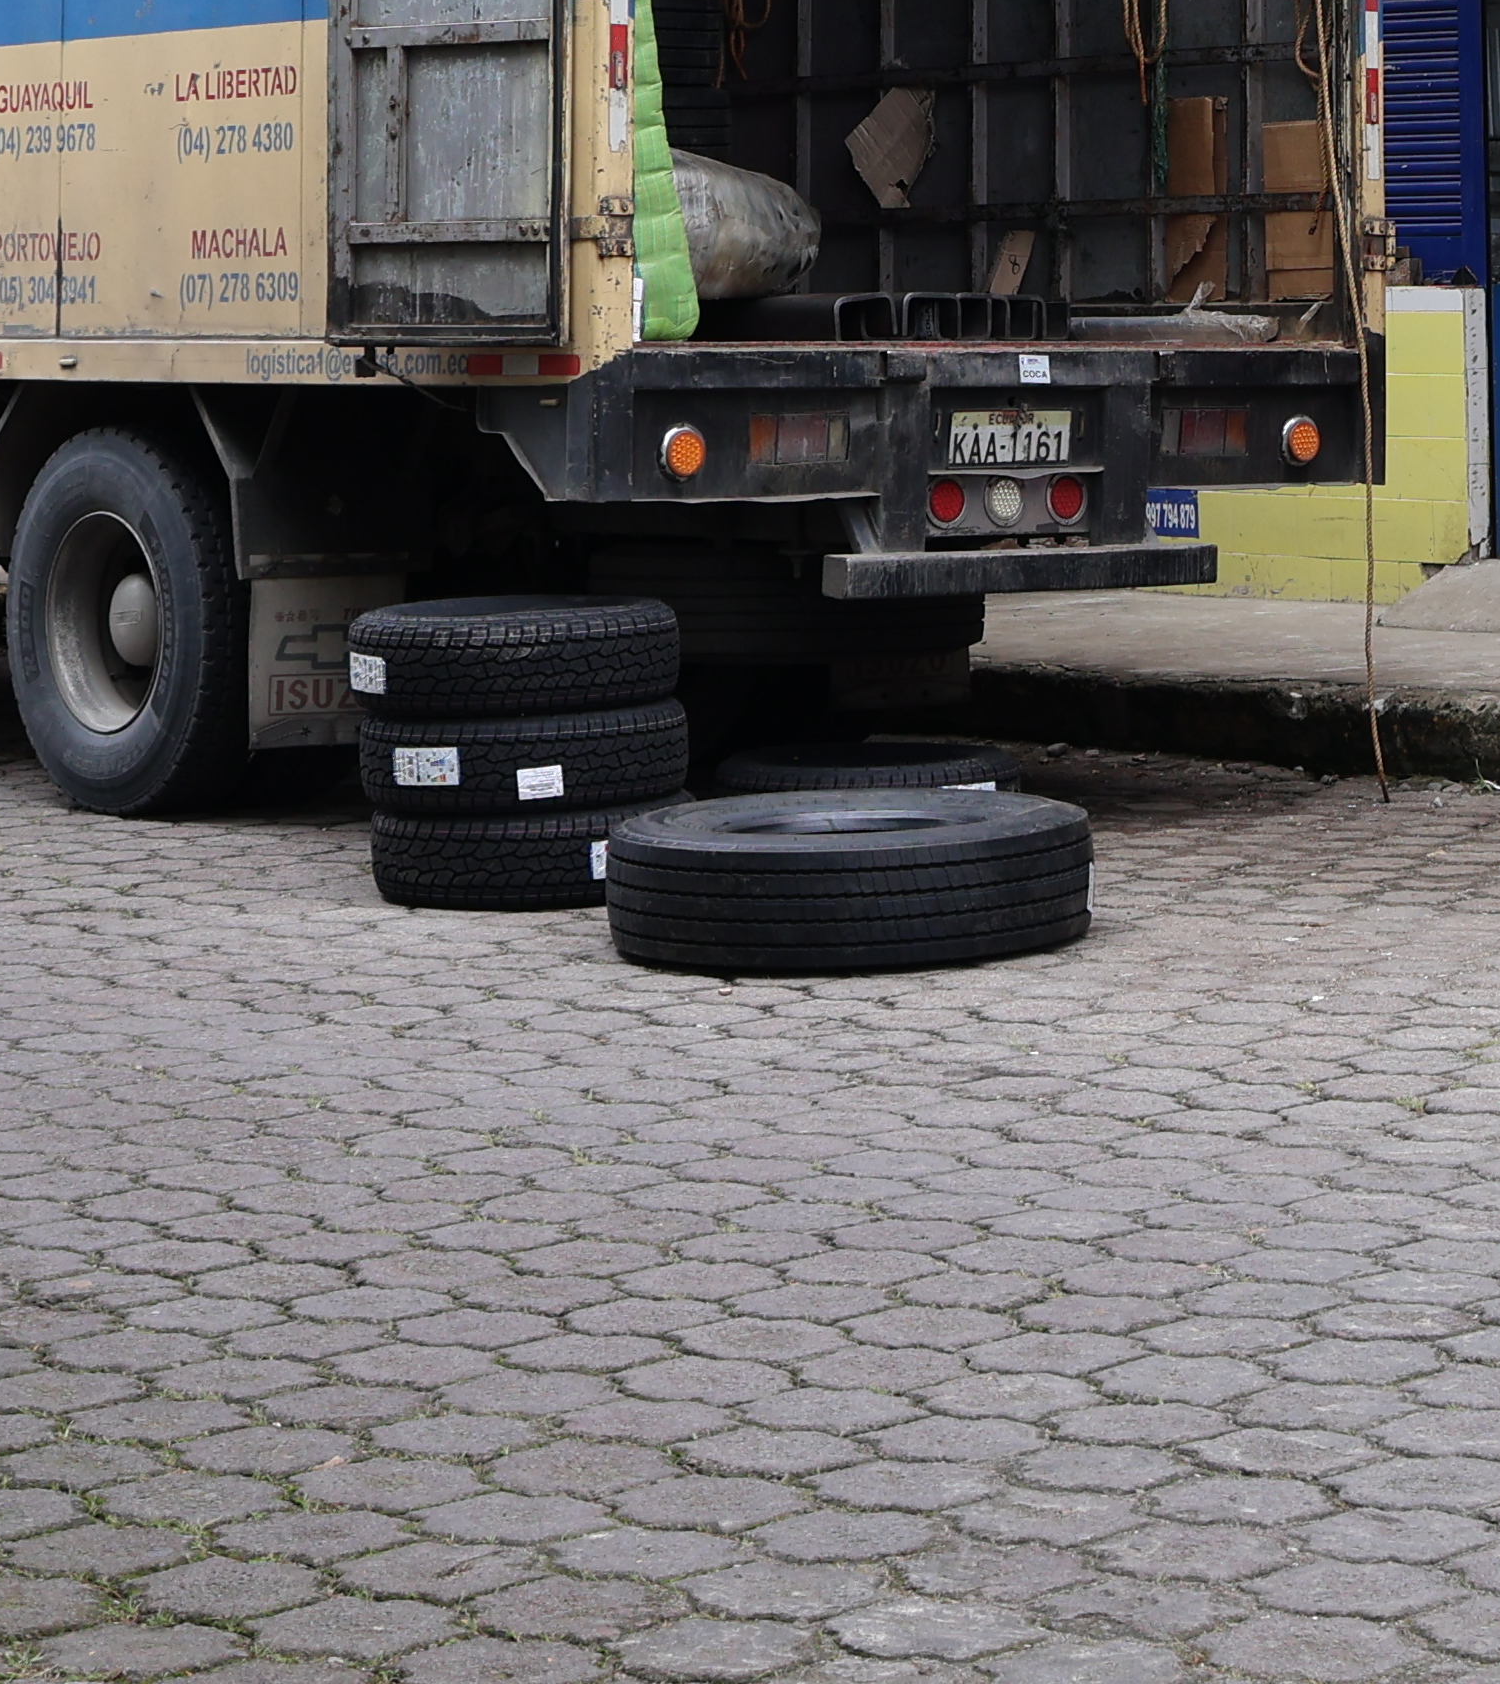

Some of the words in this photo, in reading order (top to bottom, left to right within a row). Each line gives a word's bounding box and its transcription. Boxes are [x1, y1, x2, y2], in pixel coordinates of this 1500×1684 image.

[175, 72, 200, 102] LA
[205, 66, 297, 101] LIBERTAD
[26, 124, 51, 154] 239
[56, 123, 96, 153] 9678
[177, 126, 210, 164] (04)
[216, 125, 246, 154] 278
[252, 122, 293, 153] 4380
[191, 227, 288, 259] MACHALA
[27, 275, 54, 305] 304
[61, 275, 96, 305] 3941
[180, 273, 213, 311] (07)
[220, 273, 250, 303] 278
[255, 272, 298, 302] 6309
[1023, 370, 1048, 378] COCA
[989, 413, 1034, 425] ECUAOR
[952, 430, 1064, 464] KAA-1161
[1163, 503, 1179, 525] 794
[1180, 504, 1196, 525] 879
[275, 678, 358, 711] ISUZ
